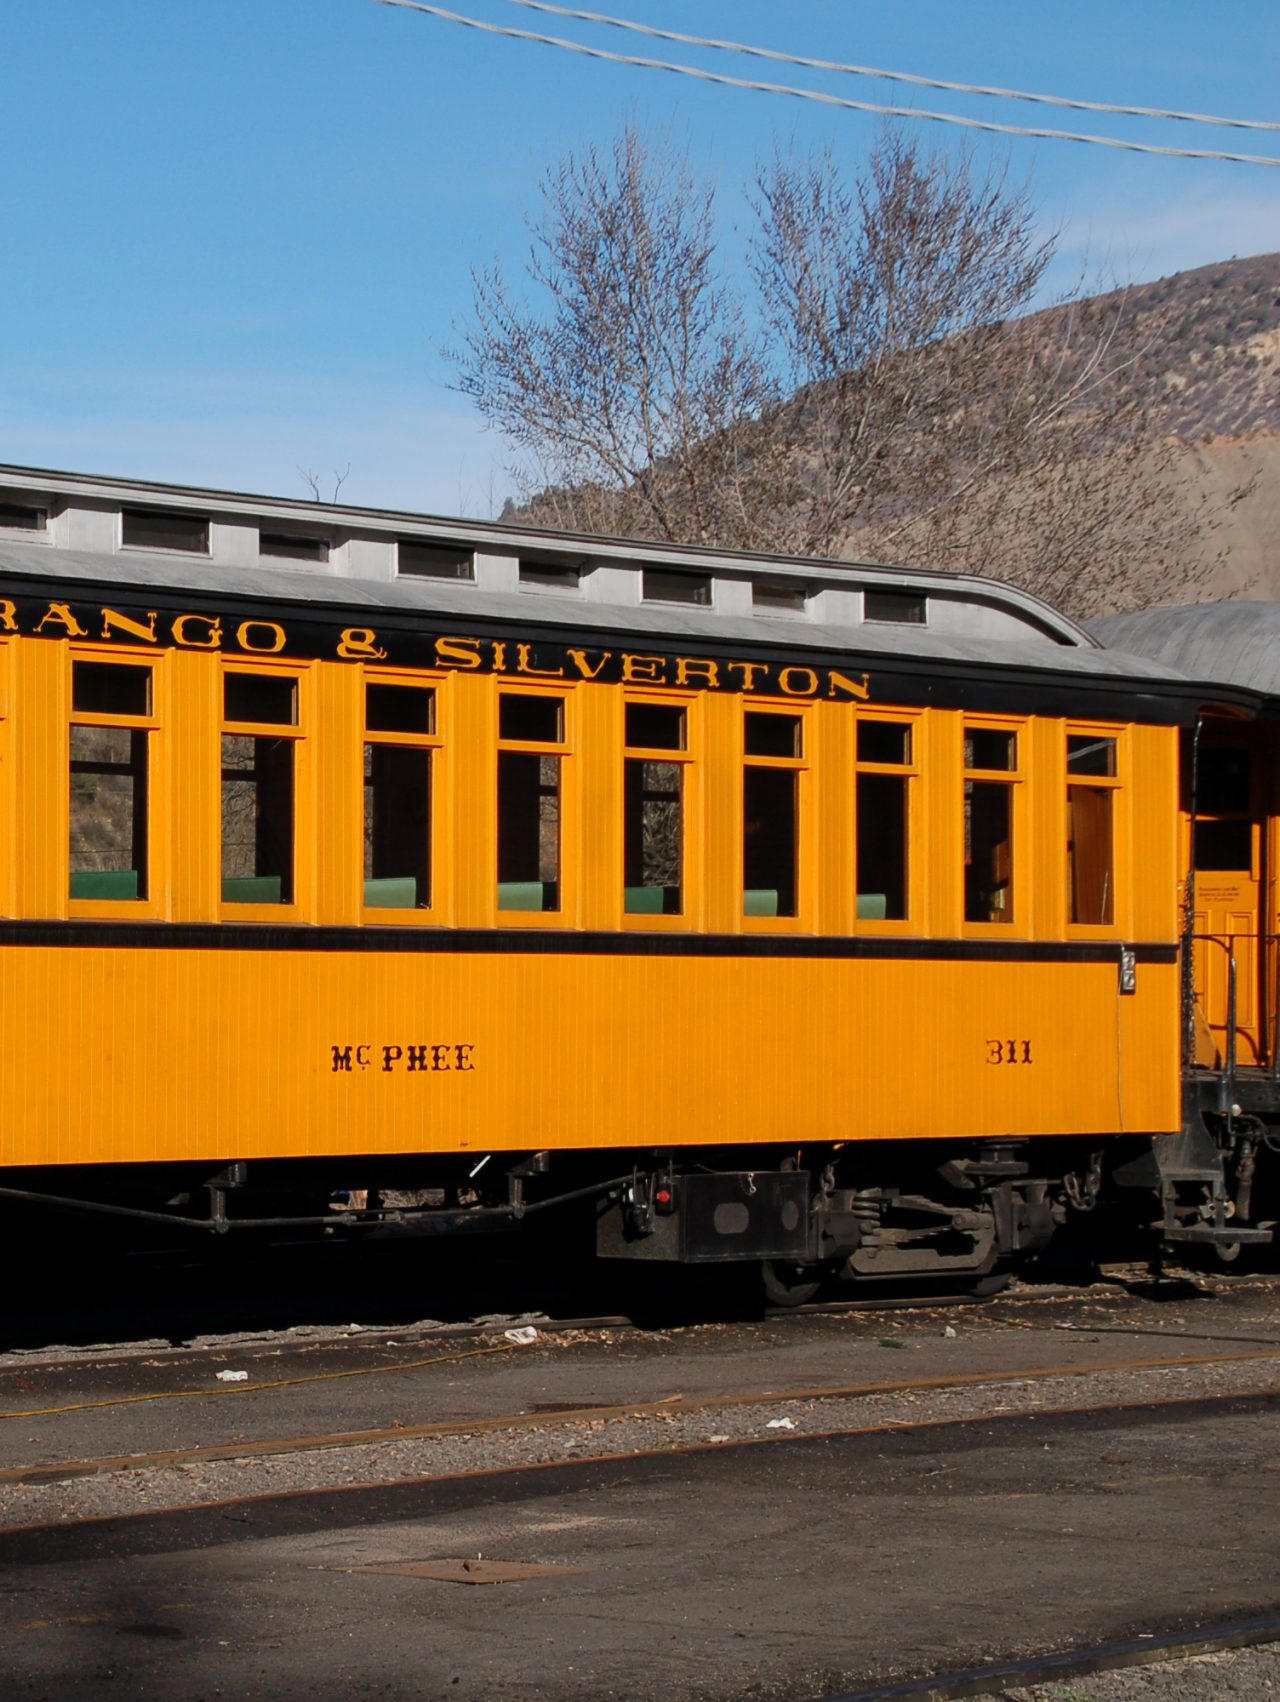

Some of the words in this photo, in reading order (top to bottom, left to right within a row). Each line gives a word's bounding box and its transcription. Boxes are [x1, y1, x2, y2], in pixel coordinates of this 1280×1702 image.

[336, 628, 388, 660] &
[433, 637, 870, 699] SILVERTON
[985, 1039, 1033, 1065] 311
